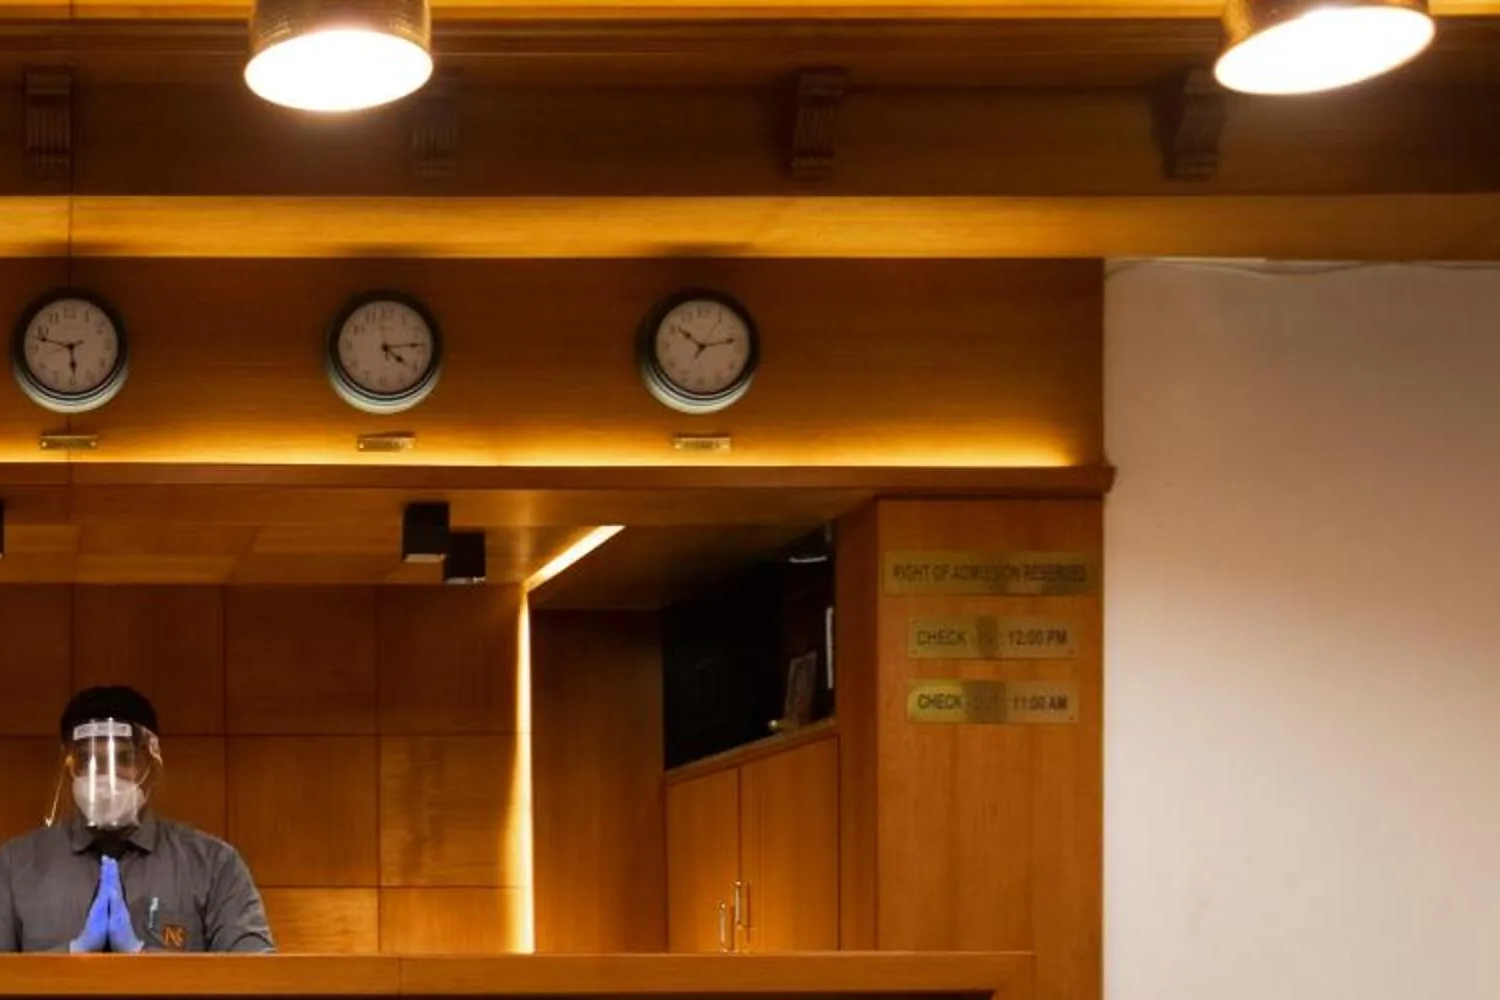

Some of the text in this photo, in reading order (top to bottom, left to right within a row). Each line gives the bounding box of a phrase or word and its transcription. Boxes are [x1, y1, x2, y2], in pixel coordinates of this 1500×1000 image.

[893, 564, 930, 582] RIGHT
[931, 564, 949, 581] OF
[916, 629, 966, 646] CHECK
[1008, 628, 1045, 646] 12:00
[1047, 628, 1069, 646] PM
[917, 693, 964, 710] CHECK
[1049, 694, 1069, 710] AM
